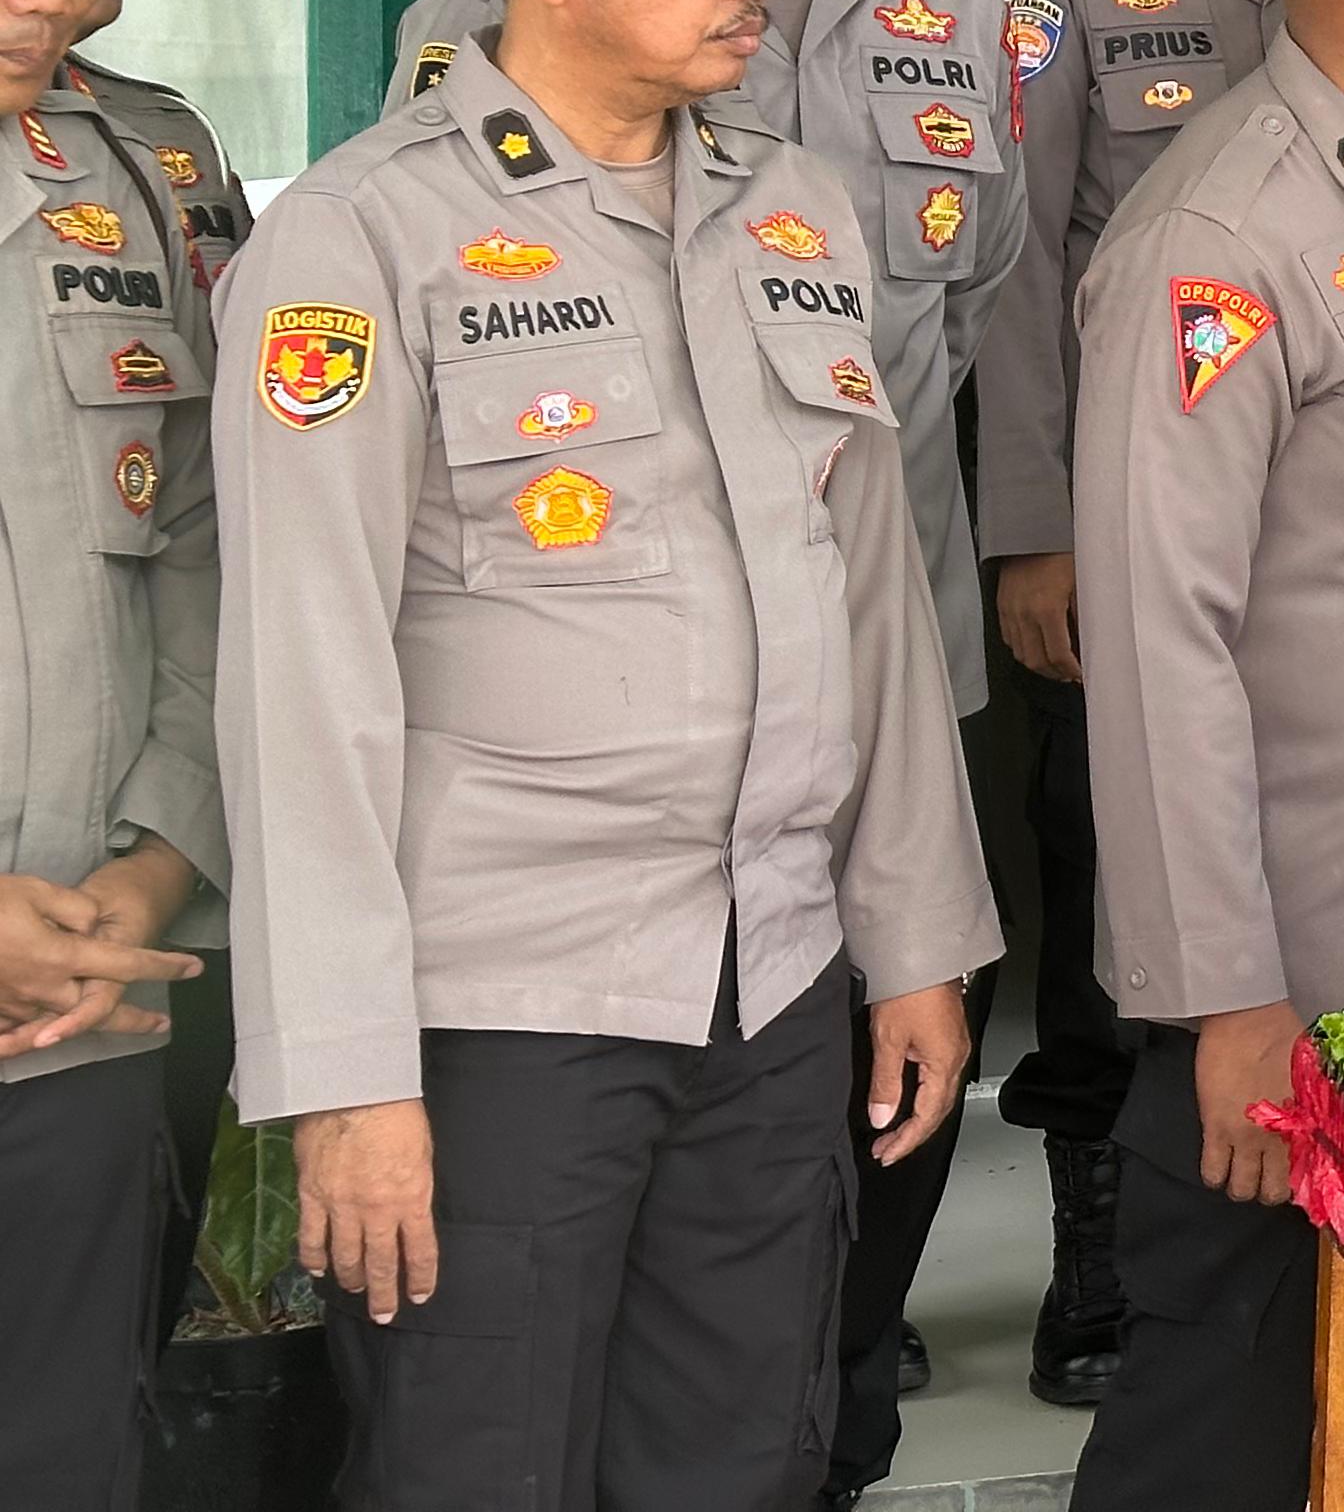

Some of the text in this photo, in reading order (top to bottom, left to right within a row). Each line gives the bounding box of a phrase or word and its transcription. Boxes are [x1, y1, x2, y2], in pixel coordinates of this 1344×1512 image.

[1104, 31, 1212, 65] PRIUS
[872, 56, 977, 92] POLRI
[53, 264, 163, 309] POLRI
[760, 277, 865, 323] POLRI
[1179, 284, 1267, 328] OPS POLRI
[273, 310, 368, 337] LOGISTIK
[459, 295, 615, 344] SAHARDI
